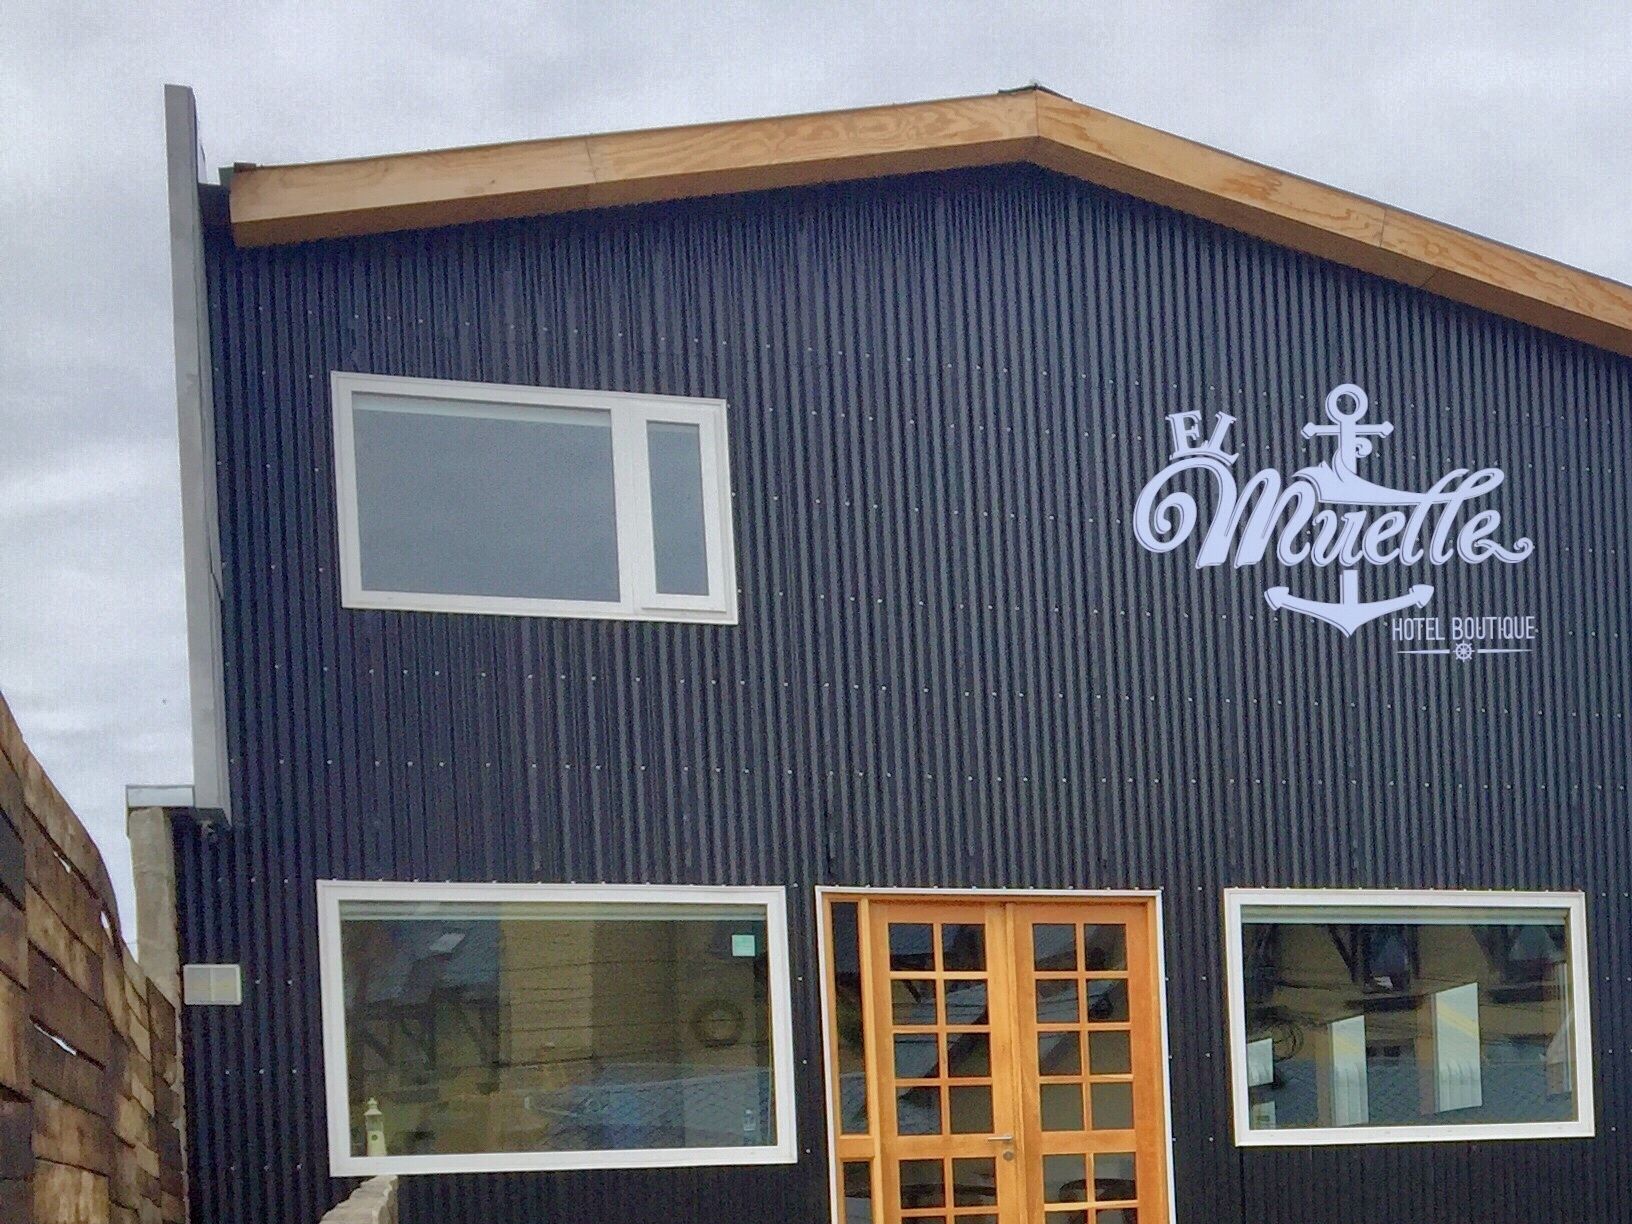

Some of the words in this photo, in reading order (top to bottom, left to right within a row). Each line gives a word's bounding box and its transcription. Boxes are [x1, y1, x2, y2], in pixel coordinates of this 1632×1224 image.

[1133, 457, 1535, 567] Muelle
[1392, 617, 1445, 641] HOTEL
[1452, 616, 1535, 640] BOUTIQUE
